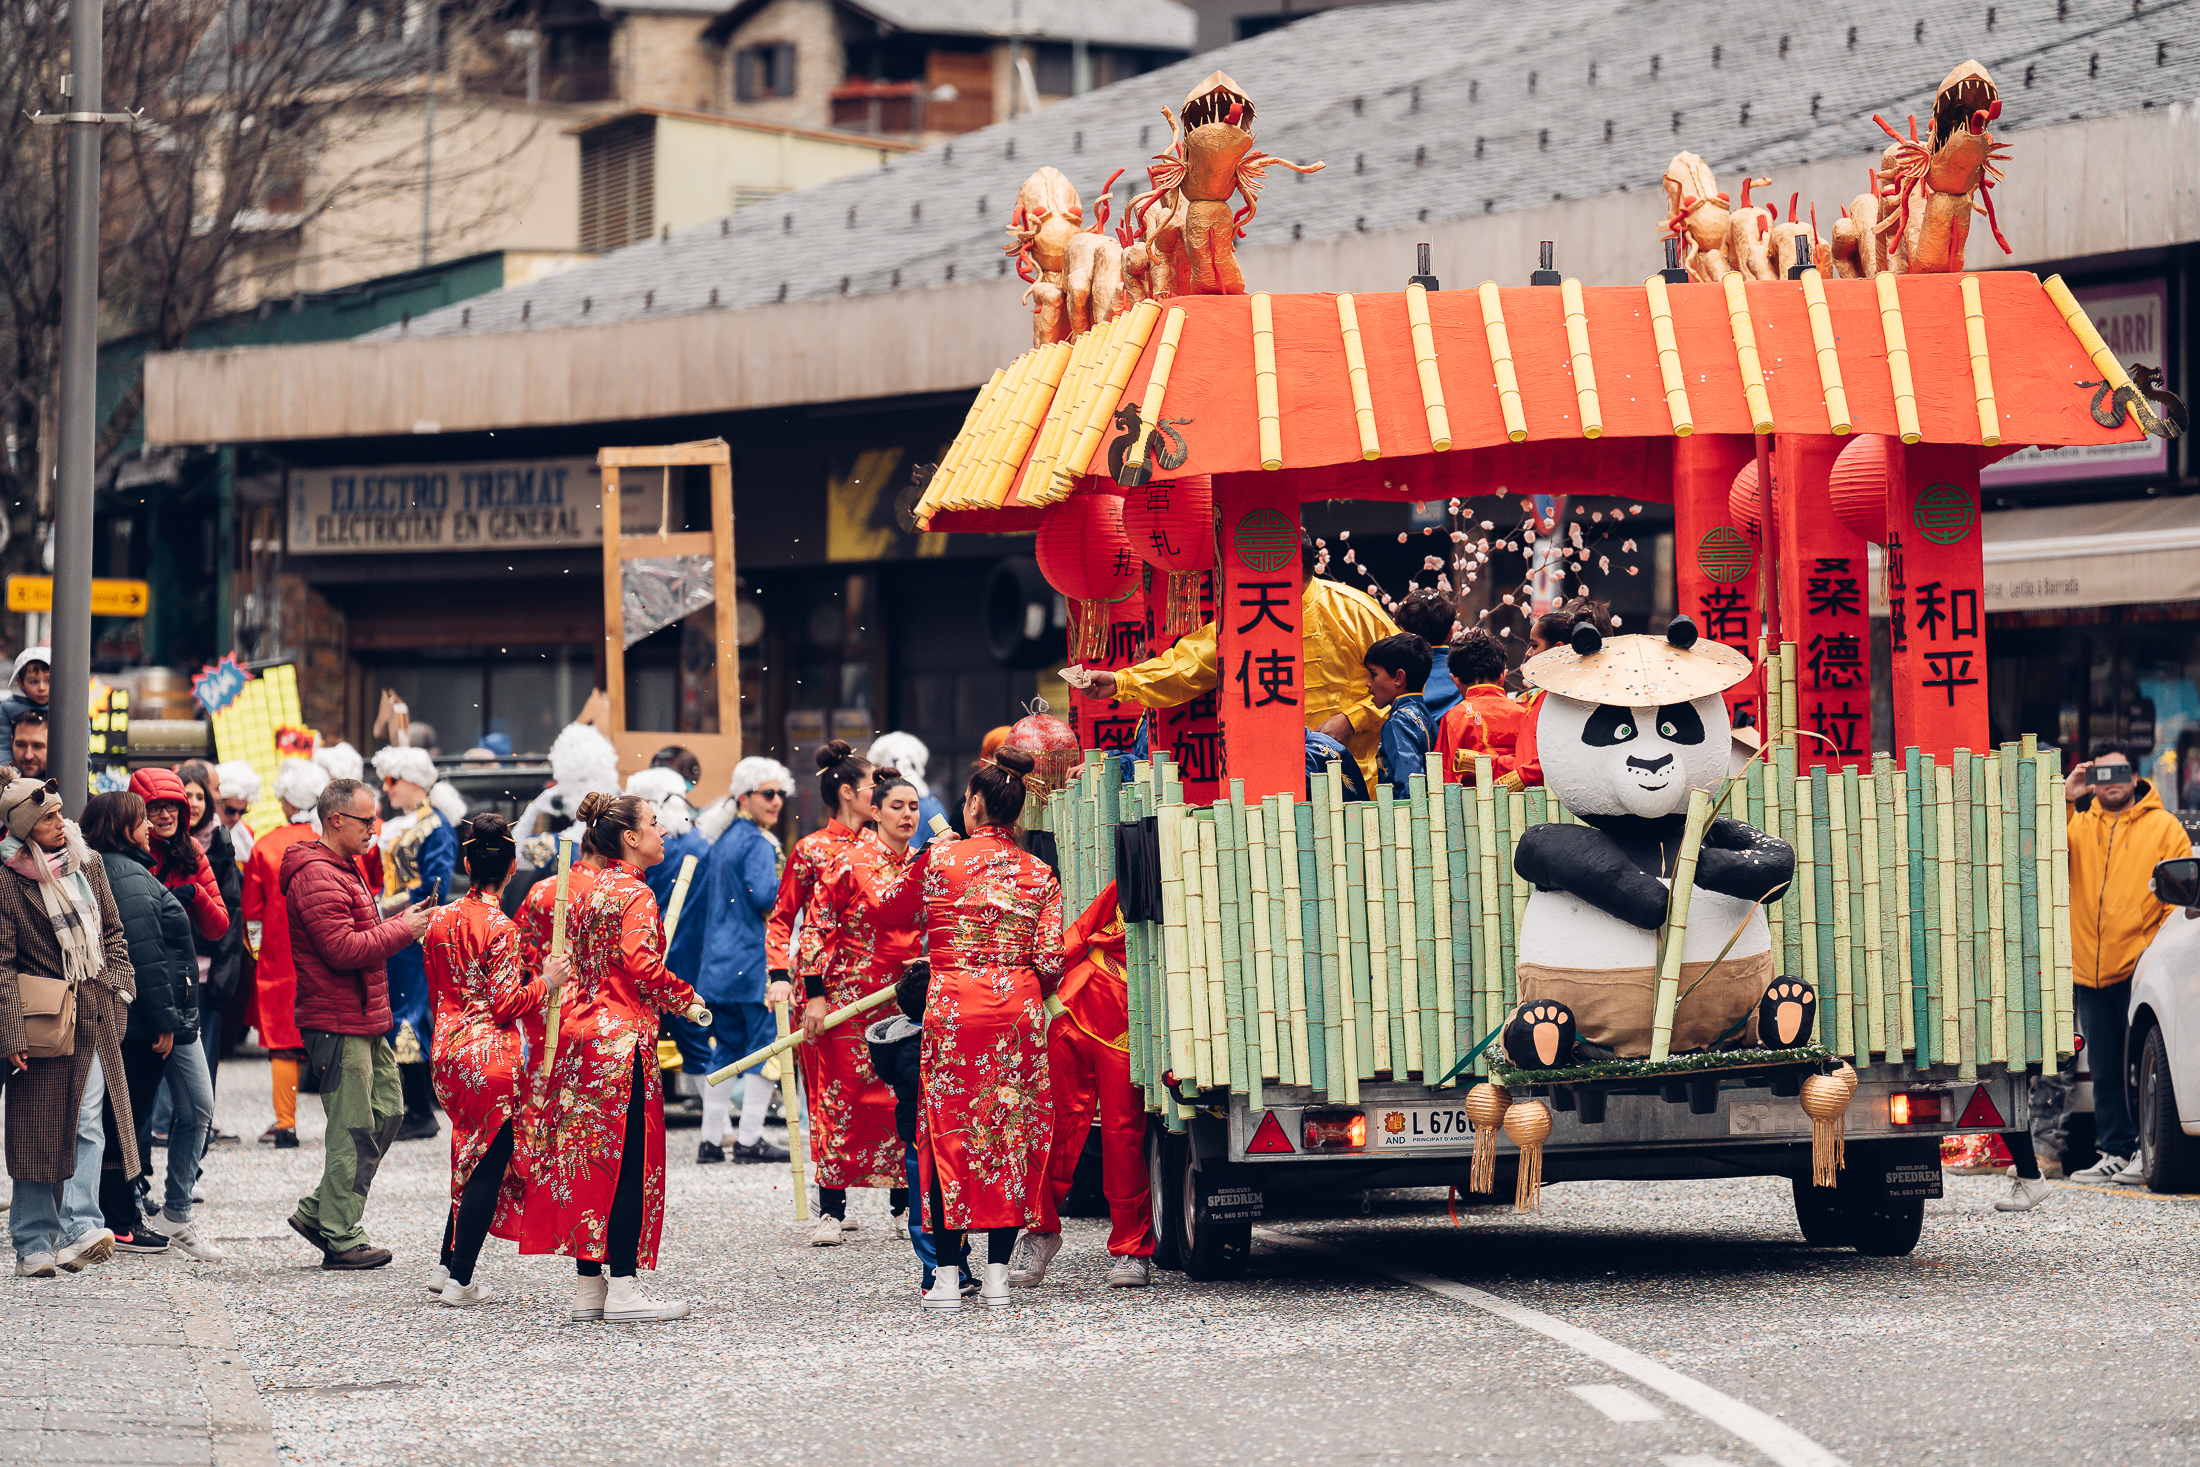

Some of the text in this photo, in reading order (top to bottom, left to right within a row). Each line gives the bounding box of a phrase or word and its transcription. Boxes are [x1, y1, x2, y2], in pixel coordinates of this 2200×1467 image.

[331, 474, 449, 512] ELECTRO
[459, 467, 569, 508] TREMAT
[315, 512, 445, 545] ELECTRICITAT
[453, 514, 480, 540] EN
[489, 506, 581, 540] GENERAL
[1234, 581, 1299, 708] 天使
[1806, 557, 1864, 757] 桑德拉
[1915, 581, 1979, 707] 和平
[1412, 1111, 1424, 1135] L
[1385, 1136, 1406, 1145] AND
[1217, 1187, 1252, 1195] REMOLQUES
[1885, 1170, 1941, 1184] SPEEDREM
[1207, 1192, 1264, 1207] SPEEDREM
